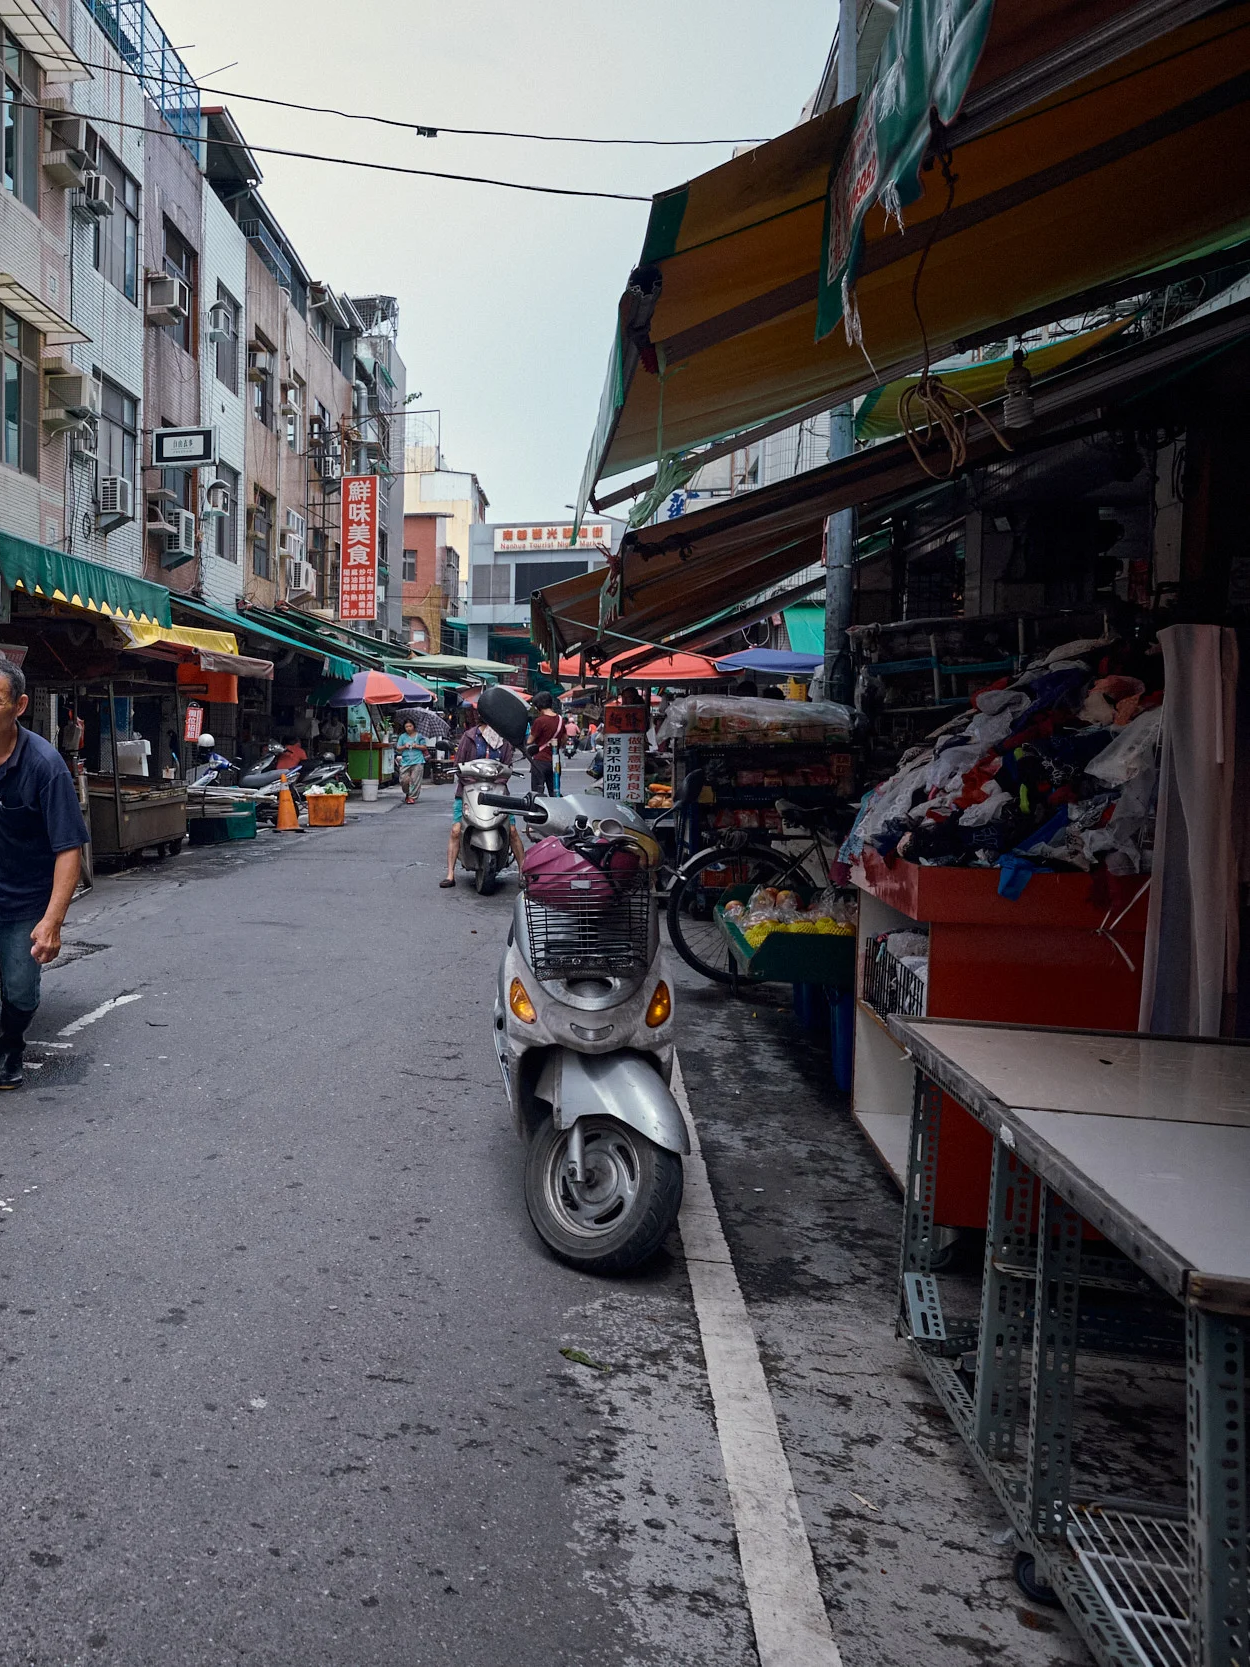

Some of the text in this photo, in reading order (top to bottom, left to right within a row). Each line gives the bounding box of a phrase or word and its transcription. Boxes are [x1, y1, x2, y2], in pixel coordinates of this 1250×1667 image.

[347, 480, 371, 565] 鮮味美食
[529, 541, 554, 549] Tourist
[607, 737, 621, 800] 堅持不加防腐劑
[627, 736, 642, 800] 做生意要有良心
